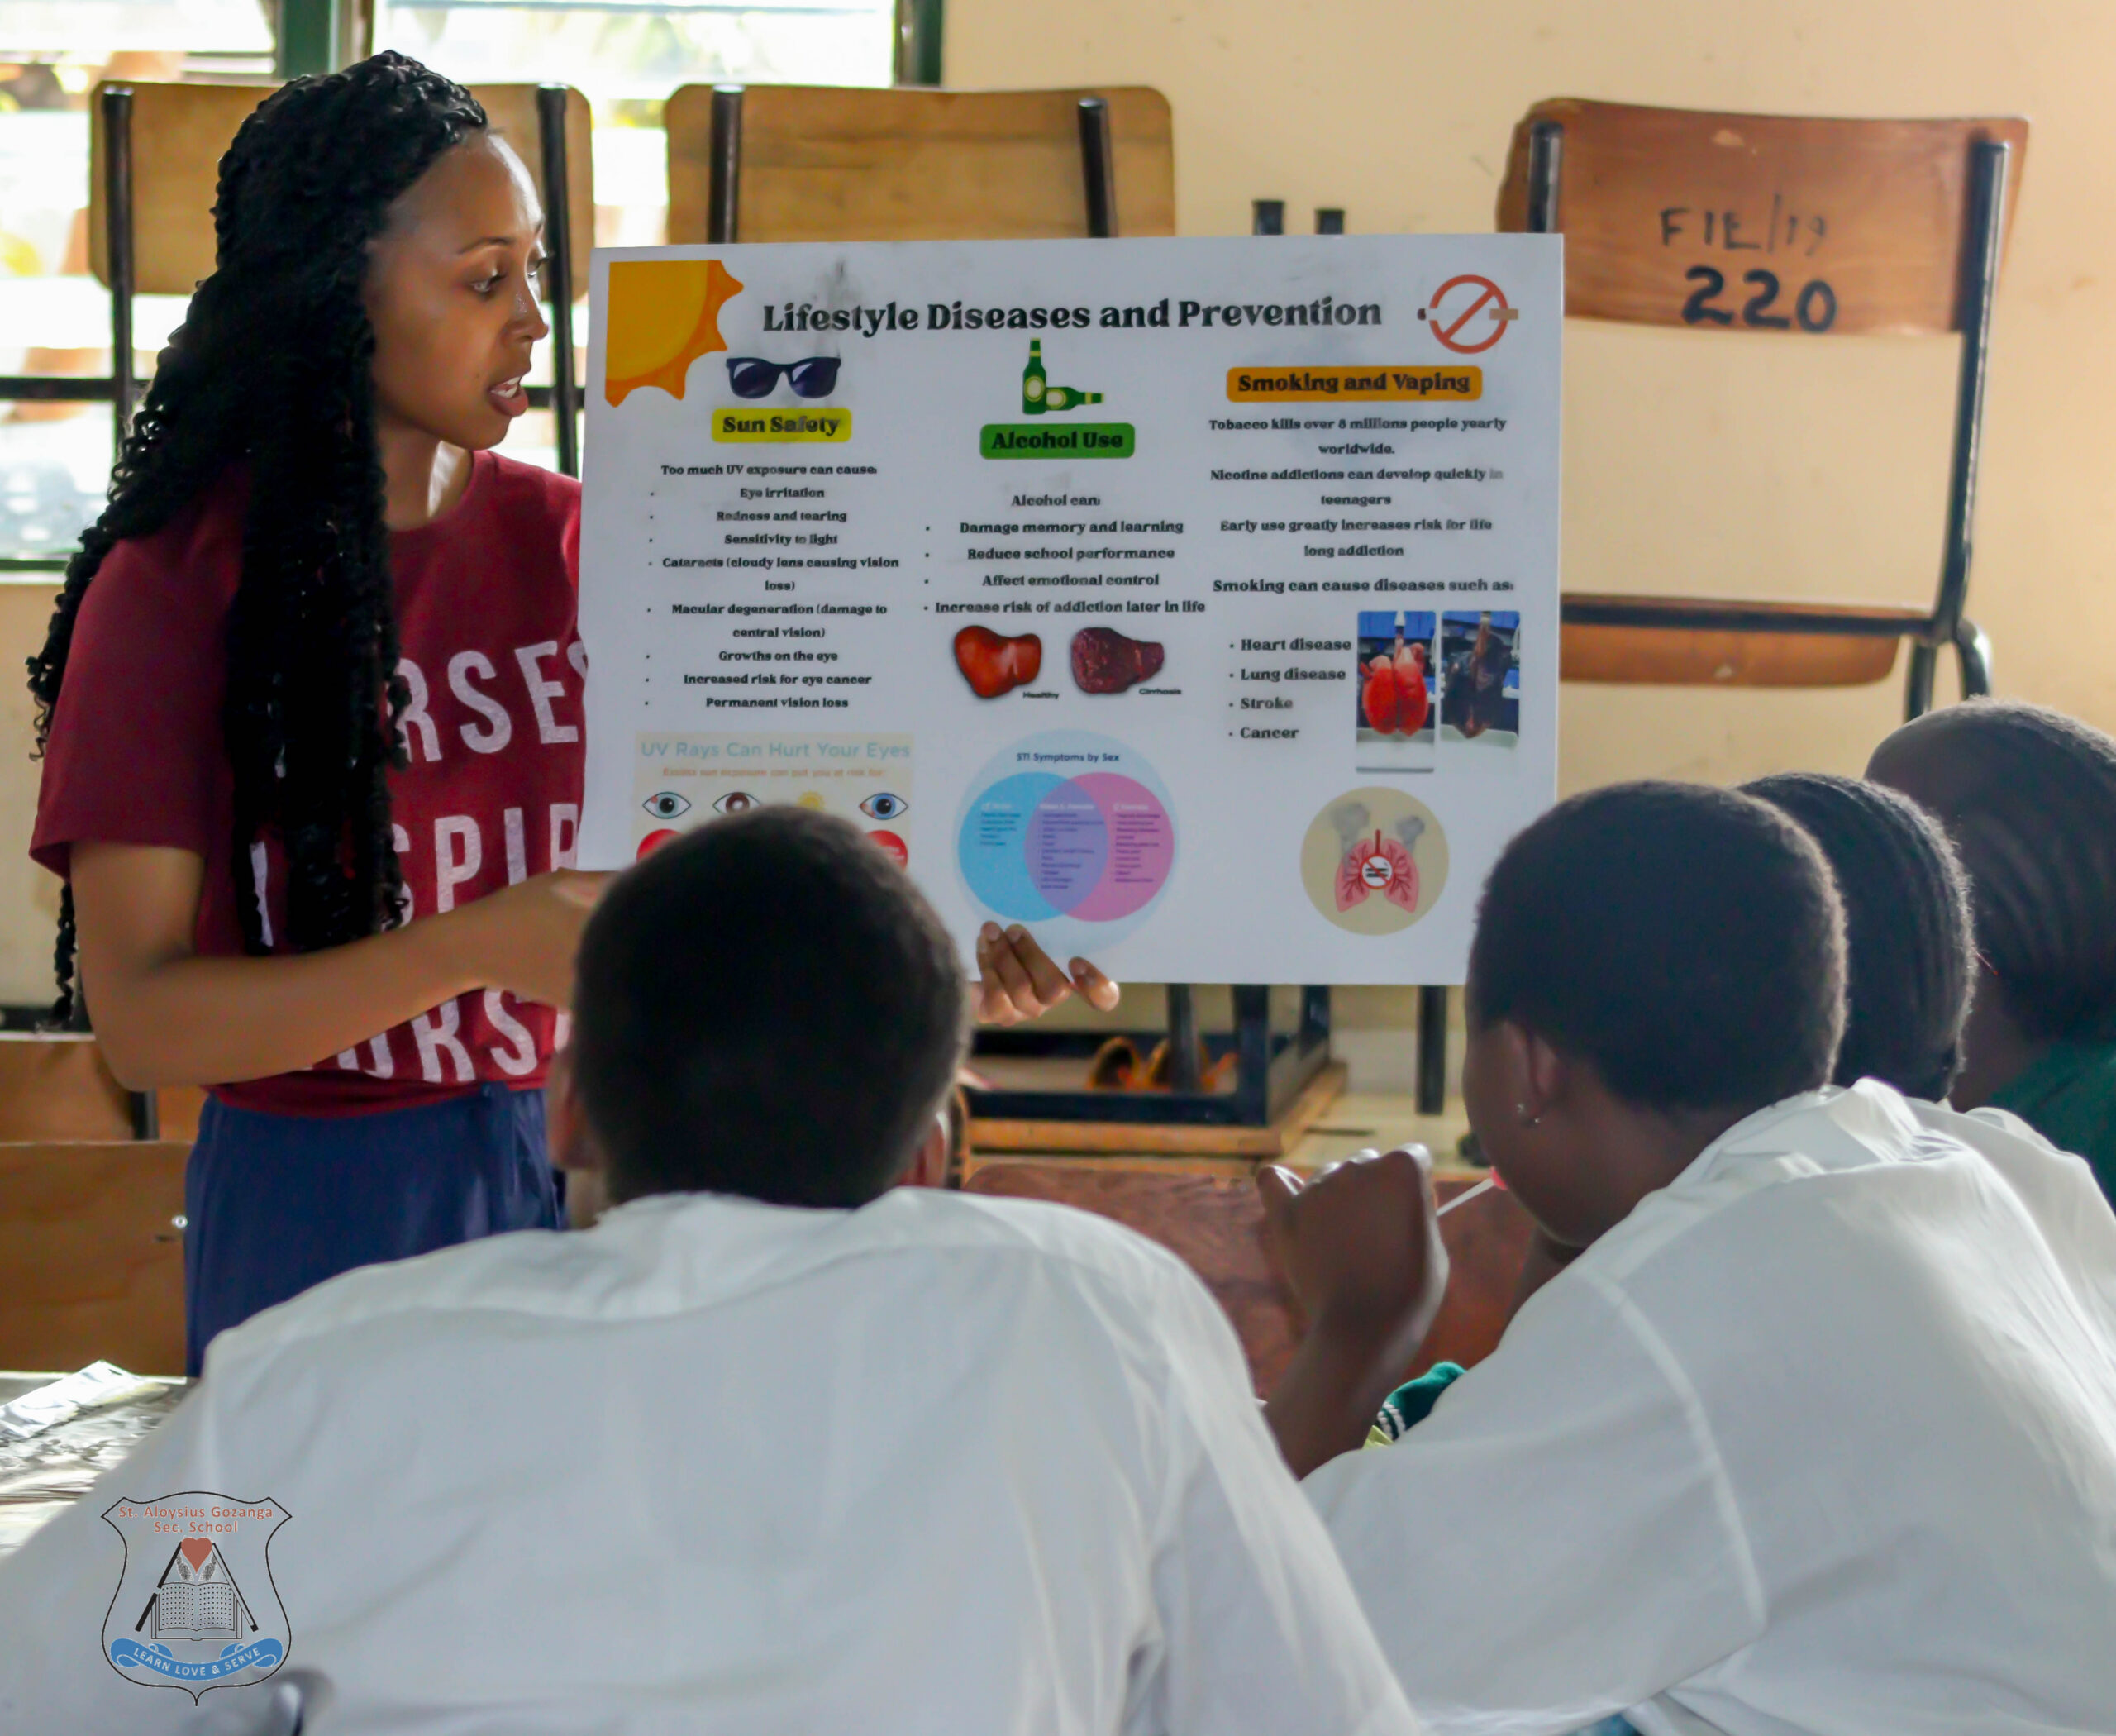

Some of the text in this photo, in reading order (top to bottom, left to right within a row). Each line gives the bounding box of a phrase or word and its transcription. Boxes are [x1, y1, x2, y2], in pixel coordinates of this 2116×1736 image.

[1681, 264, 1837, 334] 220
[762, 296, 1383, 338] Lifestyle Diseases and Prevention
[1237, 372, 1471, 395] Smoking and Vaping
[722, 414, 841, 436] Sun Safety
[1208, 417, 1508, 432] Tobacco kills over 8 millions people yearly
[991, 429, 1124, 450] Alcohol Use
[1318, 442, 1395, 455] worldwide.
[660, 465, 685, 475] Too
[686, 464, 724, 475] much
[726, 465, 745, 475] UV
[746, 465, 808, 478] exposure
[809, 465, 834, 475] can
[1210, 467, 1503, 483] Nicotine addictions can develop quickly in
[740, 486, 826, 501] Eye irritation
[1011, 494, 1068, 507] Alcohol
[1320, 495, 1392, 508] teenagers
[716, 510, 847, 523] Redness and tearing
[960, 519, 1184, 536] Damage memory and learning
[1220, 518, 1493, 534] Early use greatly increases risk for life
[724, 533, 838, 547] Sensitivity to light
[967, 546, 1175, 562] Reduce school performance
[1303, 544, 1404, 559] long addiction
[662, 556, 900, 570] Cataracts (cloudy lens causing vision
[765, 579, 796, 591] loss)
[982, 573, 1160, 587] Affect emotional control
[1213, 578, 1285, 594] Smoking
[1288, 581, 1318, 592] can
[1321, 581, 1370, 592] cause
[1373, 578, 1446, 592] diseases
[1448, 578, 1489, 592] such
[671, 603, 888, 617] Macular degeneration (damage to
[935, 599, 1206, 613] Increase risk of addiction later in life
[732, 626, 826, 638] central vision)
[1241, 637, 1352, 651] Heart disease
[718, 650, 839, 664] Growths on the eye
[684, 673, 873, 687] Increased risk for eye cancer
[1241, 666, 1346, 683] Lung disease
[706, 696, 849, 708] Permanent vision loss
[1240, 696, 1294, 710] Stroke
[1240, 727, 1300, 739] Cancer
[641, 742, 910, 760] UV Rays Can Hurt Your Eyes
[1016, 751, 1120, 764] STI Symptoms by Sex
